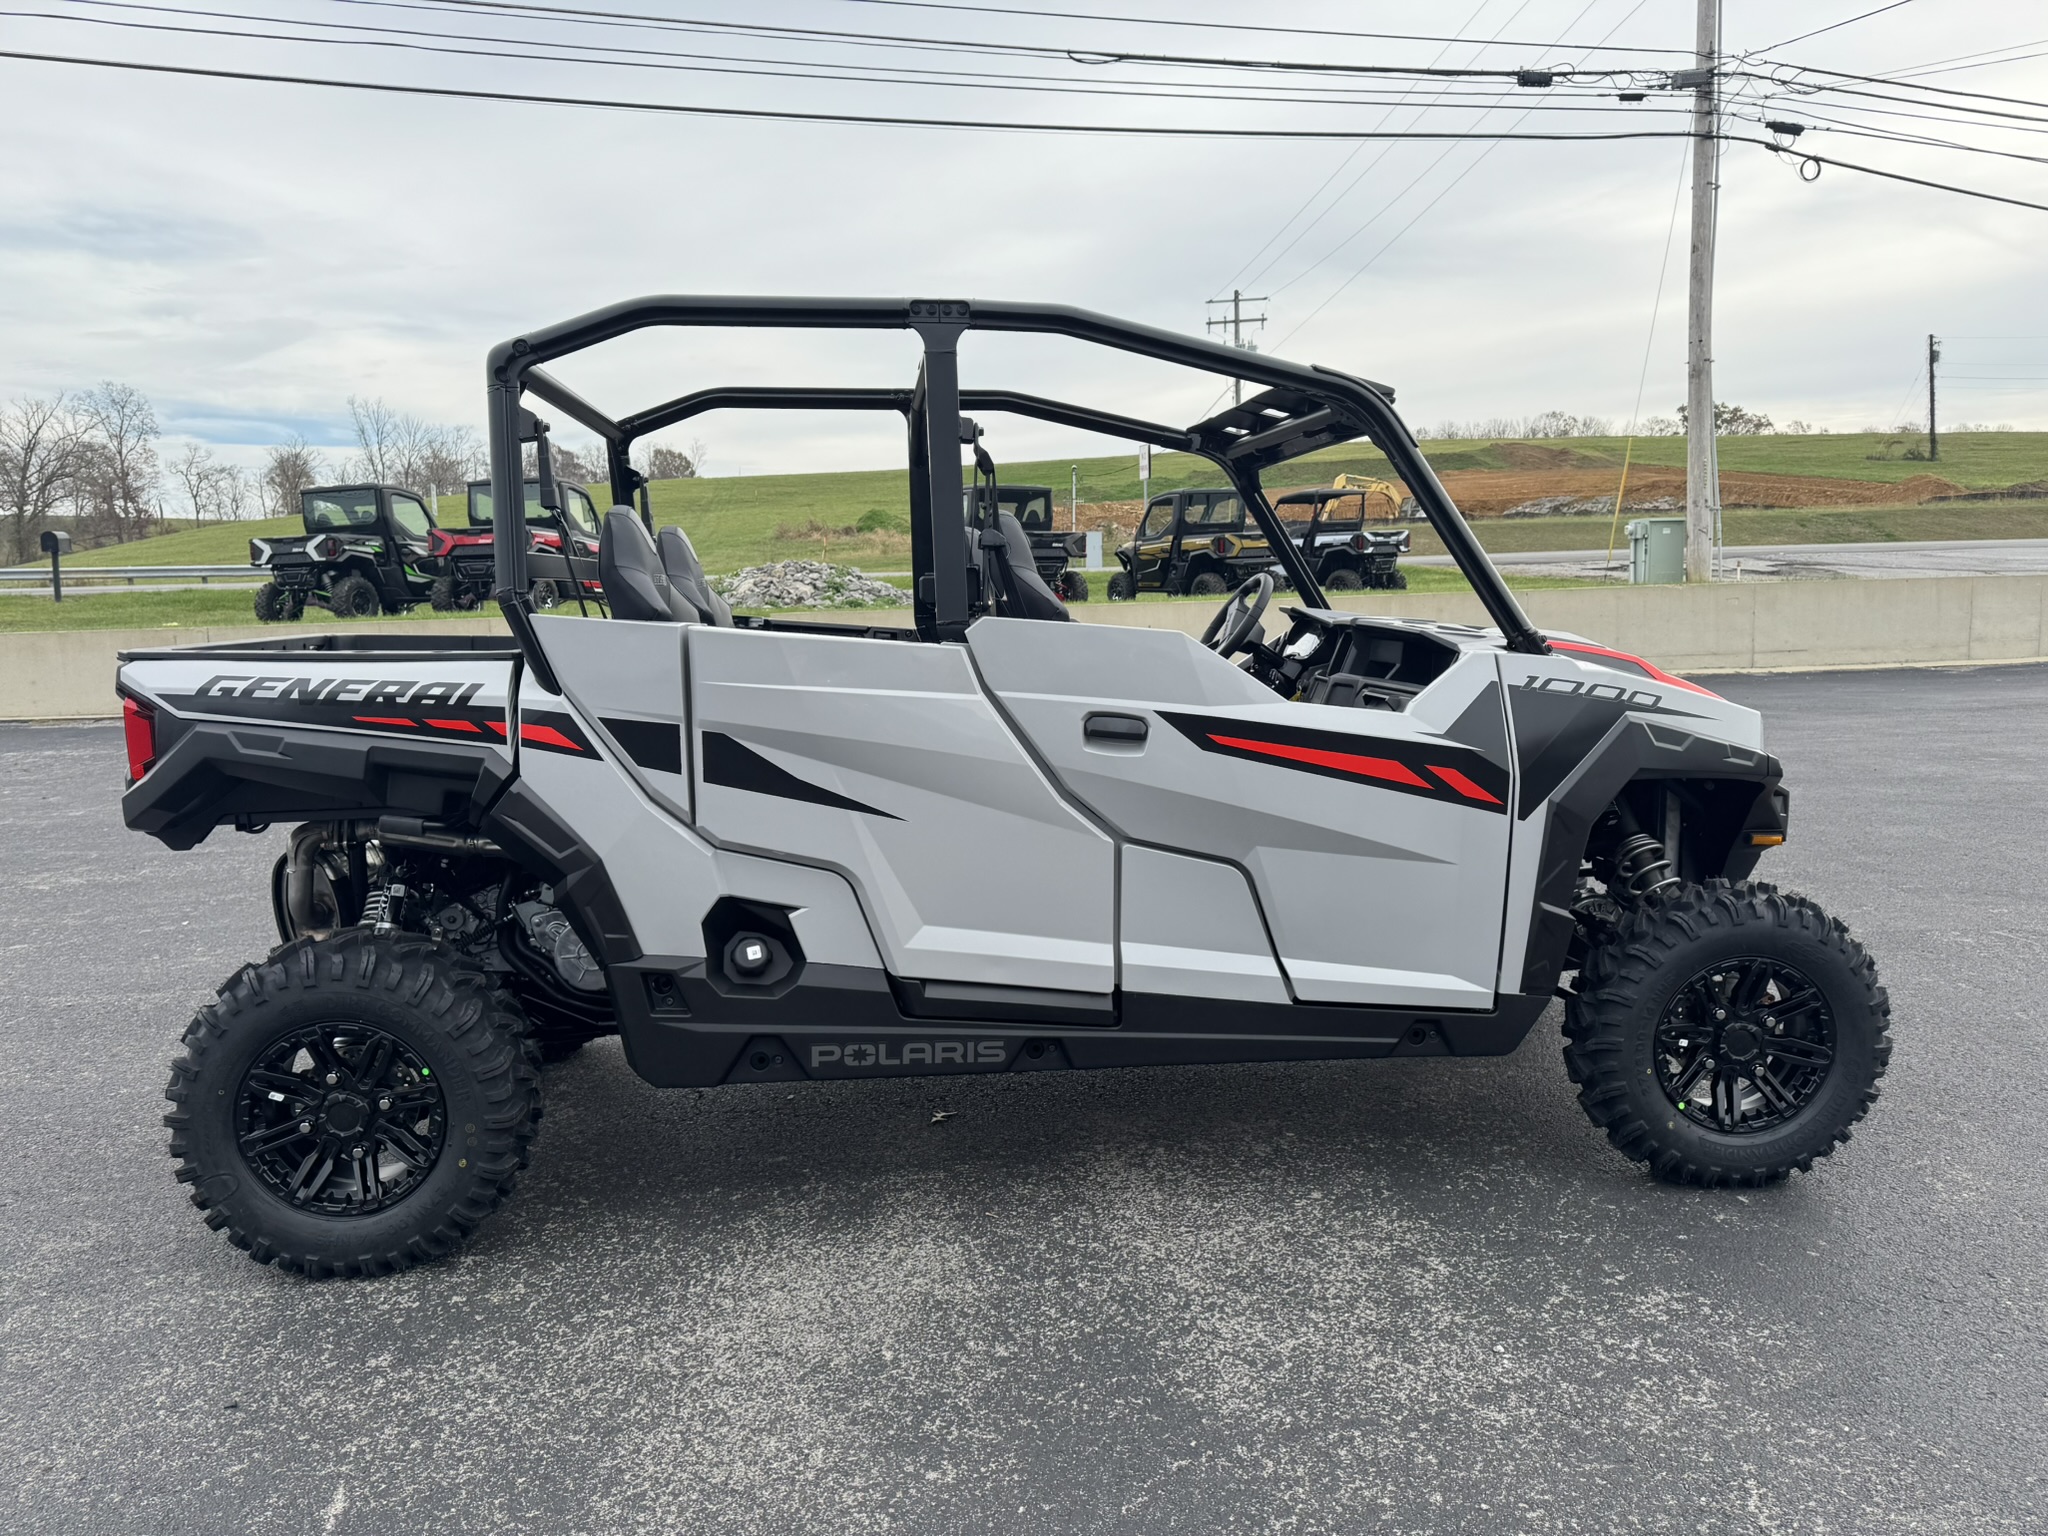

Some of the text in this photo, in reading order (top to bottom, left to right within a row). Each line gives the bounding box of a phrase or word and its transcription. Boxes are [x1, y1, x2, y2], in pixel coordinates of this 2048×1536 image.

[195, 674, 486, 706] GENERAL
[1520, 675, 1663, 709] 1000
[810, 1041, 1006, 1067] POLARIS
